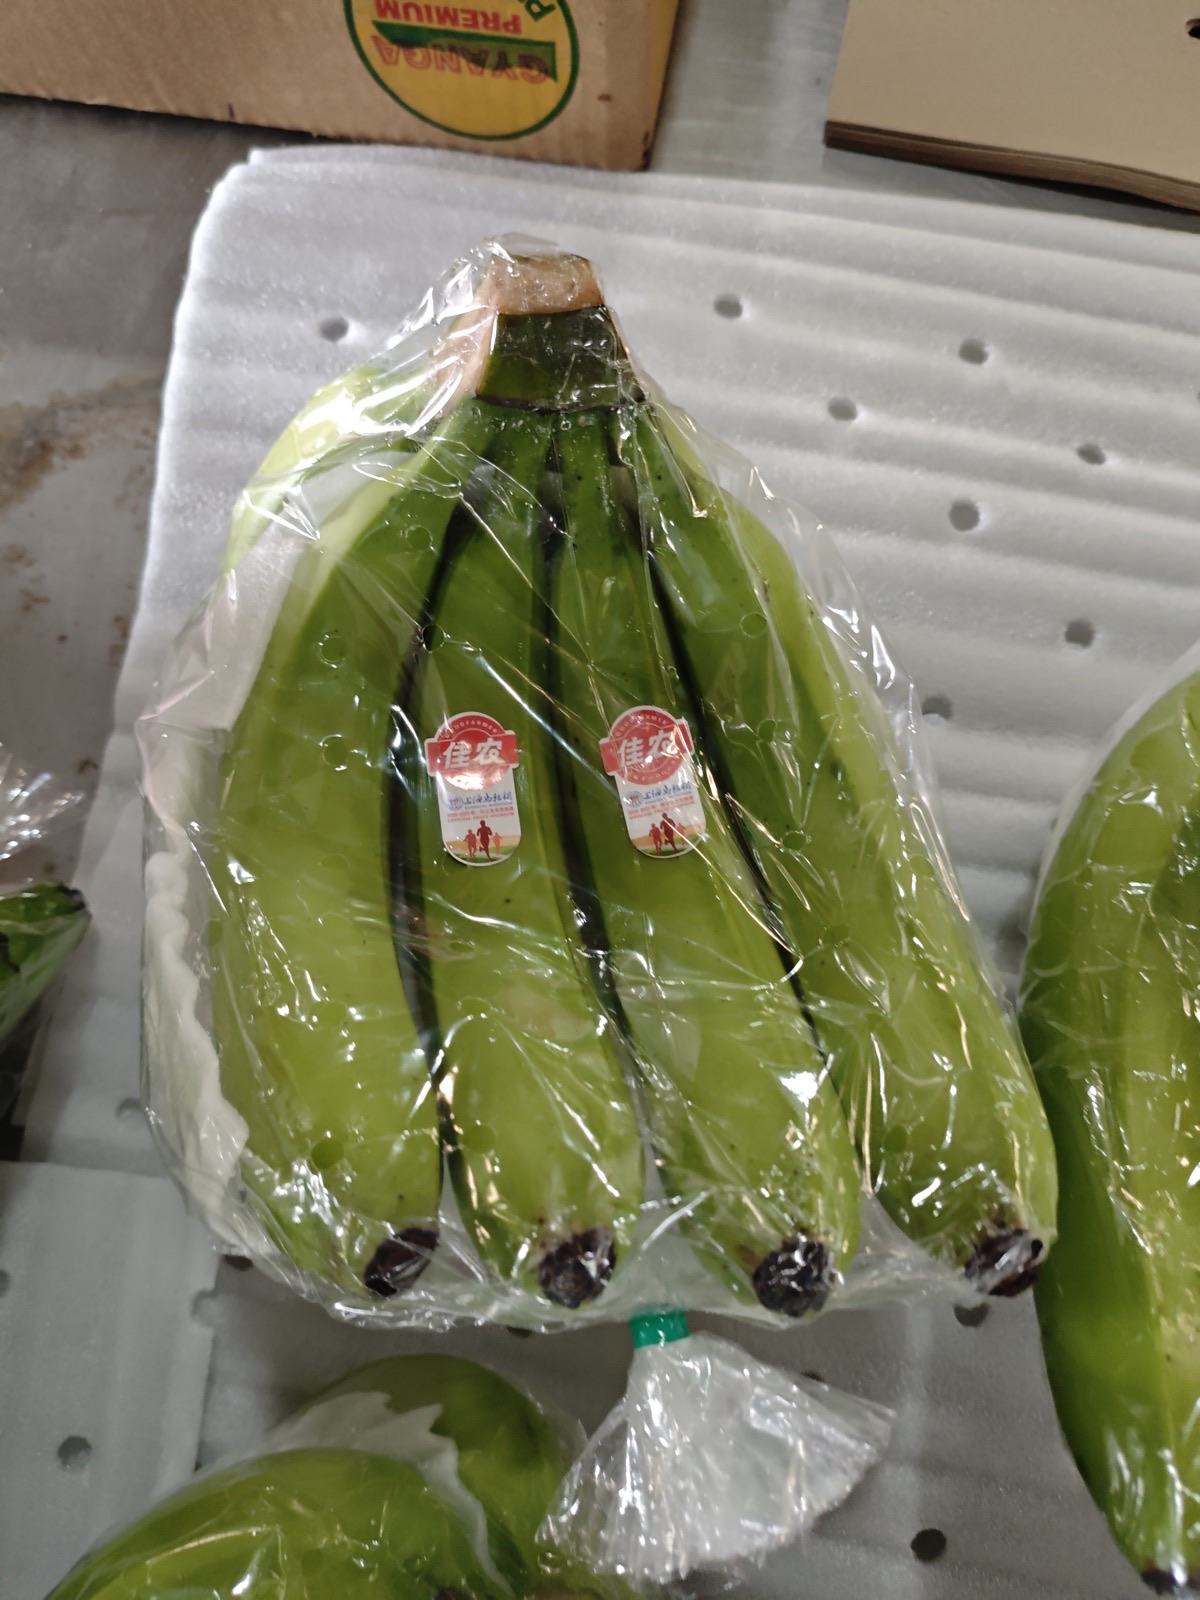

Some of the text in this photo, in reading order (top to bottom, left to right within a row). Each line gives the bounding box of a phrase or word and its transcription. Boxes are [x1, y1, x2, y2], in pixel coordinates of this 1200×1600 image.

[374, 0, 522, 35] PREMIUM
[370, 34, 549, 85] GYANGA
[443, 737, 506, 769] 佳农
[617, 729, 679, 769] 佳农
